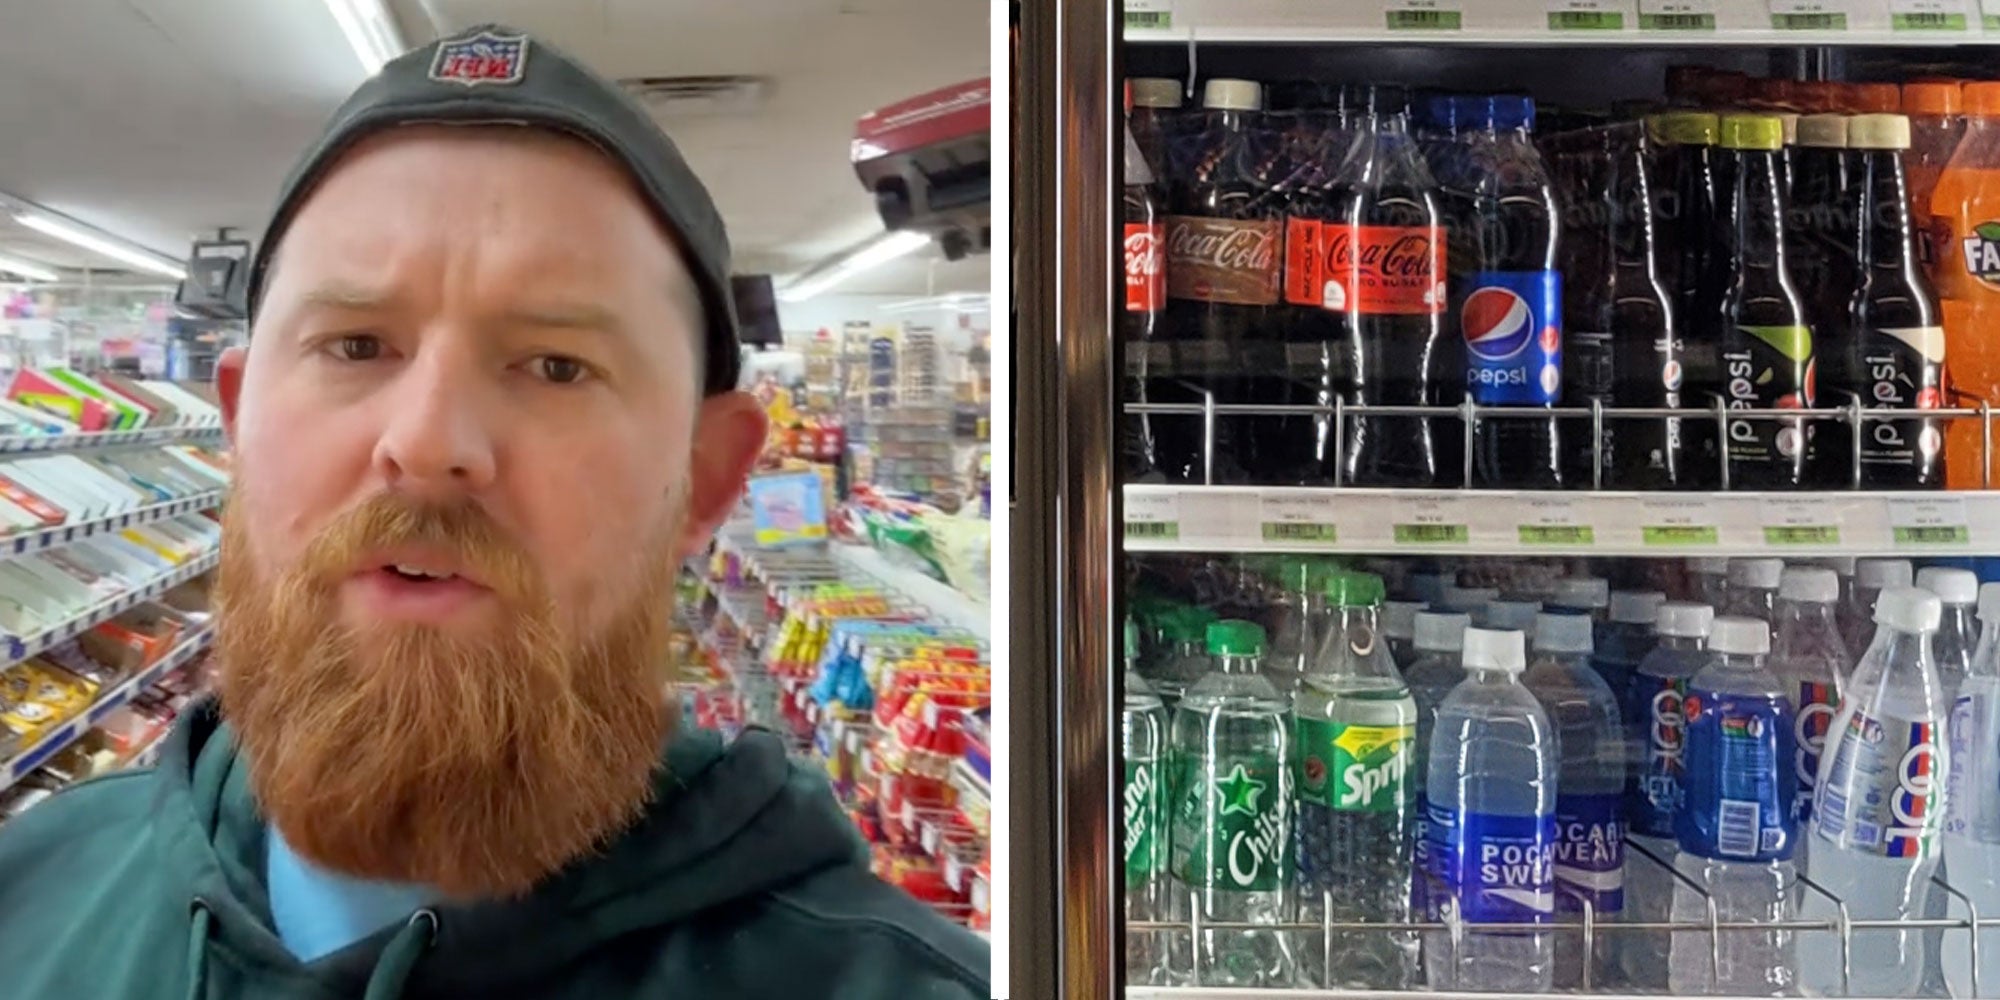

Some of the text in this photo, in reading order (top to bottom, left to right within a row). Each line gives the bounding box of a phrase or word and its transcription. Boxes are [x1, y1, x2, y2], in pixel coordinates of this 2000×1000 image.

[1169, 223, 1275, 270] Coca-Cola
[1328, 232, 1434, 275] Ca-Col
[1467, 365, 1527, 389] pepsi
[1341, 739, 1415, 806] Spri
[1885, 743, 1943, 843] 100
